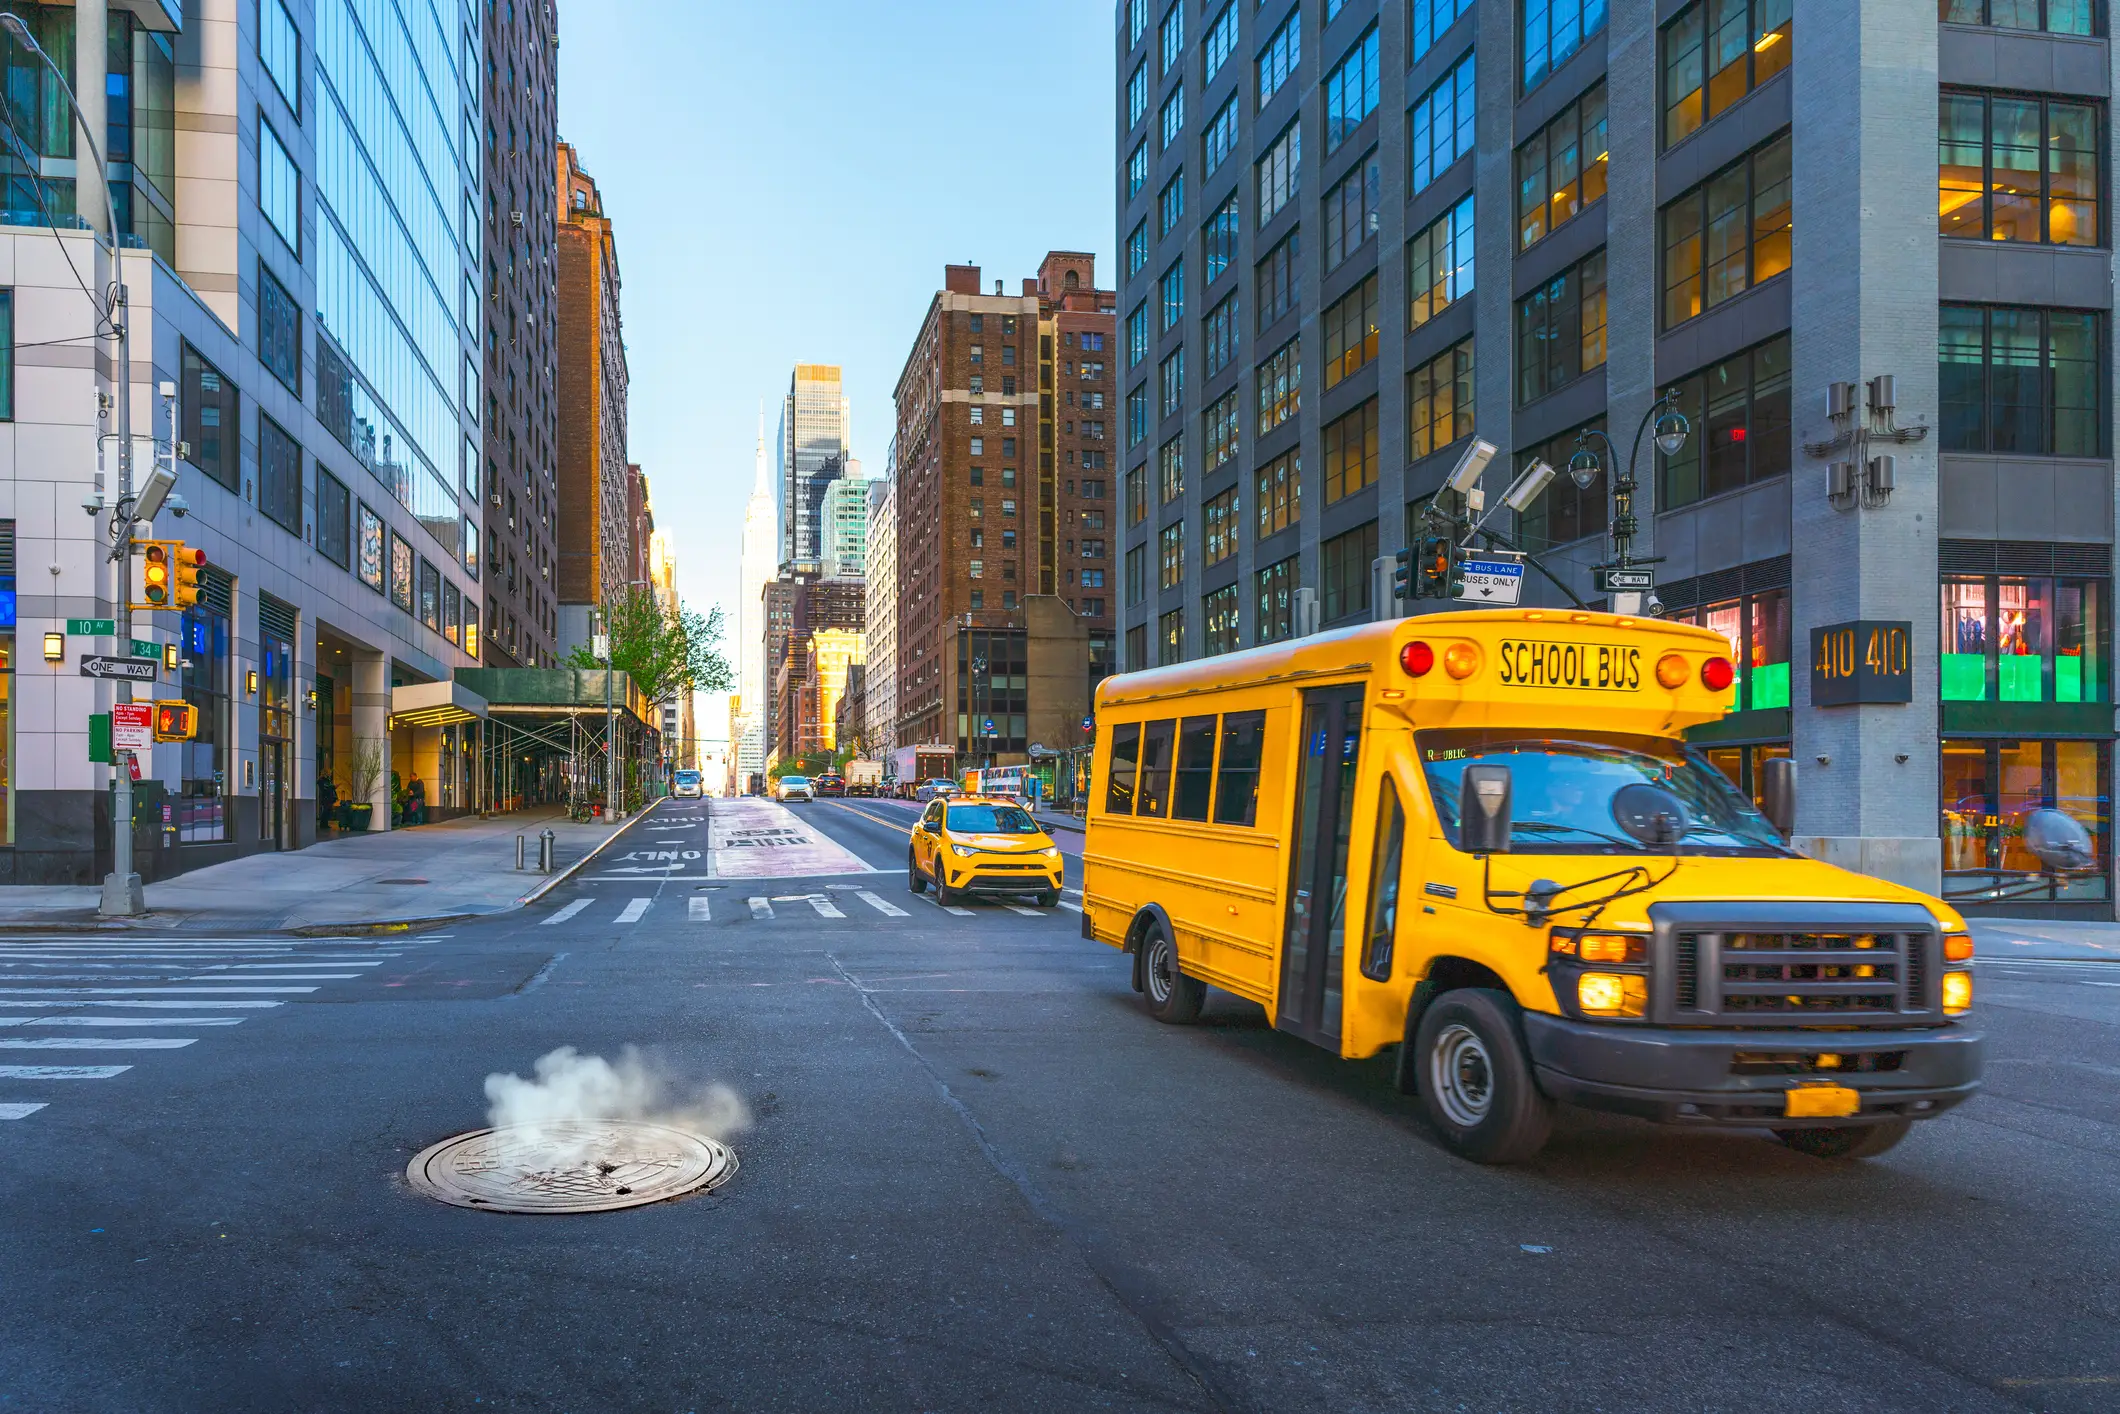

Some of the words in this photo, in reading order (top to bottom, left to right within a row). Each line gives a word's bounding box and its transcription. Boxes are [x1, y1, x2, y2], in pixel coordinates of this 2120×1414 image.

[1475, 564, 1491, 572] BUS
[1494, 566, 1518, 574] LANE
[1460, 575, 1489, 584] BUSES
[1493, 577, 1516, 586] ONLY
[79, 621, 91, 634] 10
[140, 643, 151, 656] 34
[1815, 629, 1855, 679] 410
[1865, 626, 1907, 676] 410
[90, 662, 114, 672] ONE
[126, 665, 151, 676] WAY
[1500, 641, 1591, 687] SCHOOL
[1598, 646, 1640, 689] BUS
[642, 816, 705, 824] ONLY
[610, 850, 701, 861] ONLY
